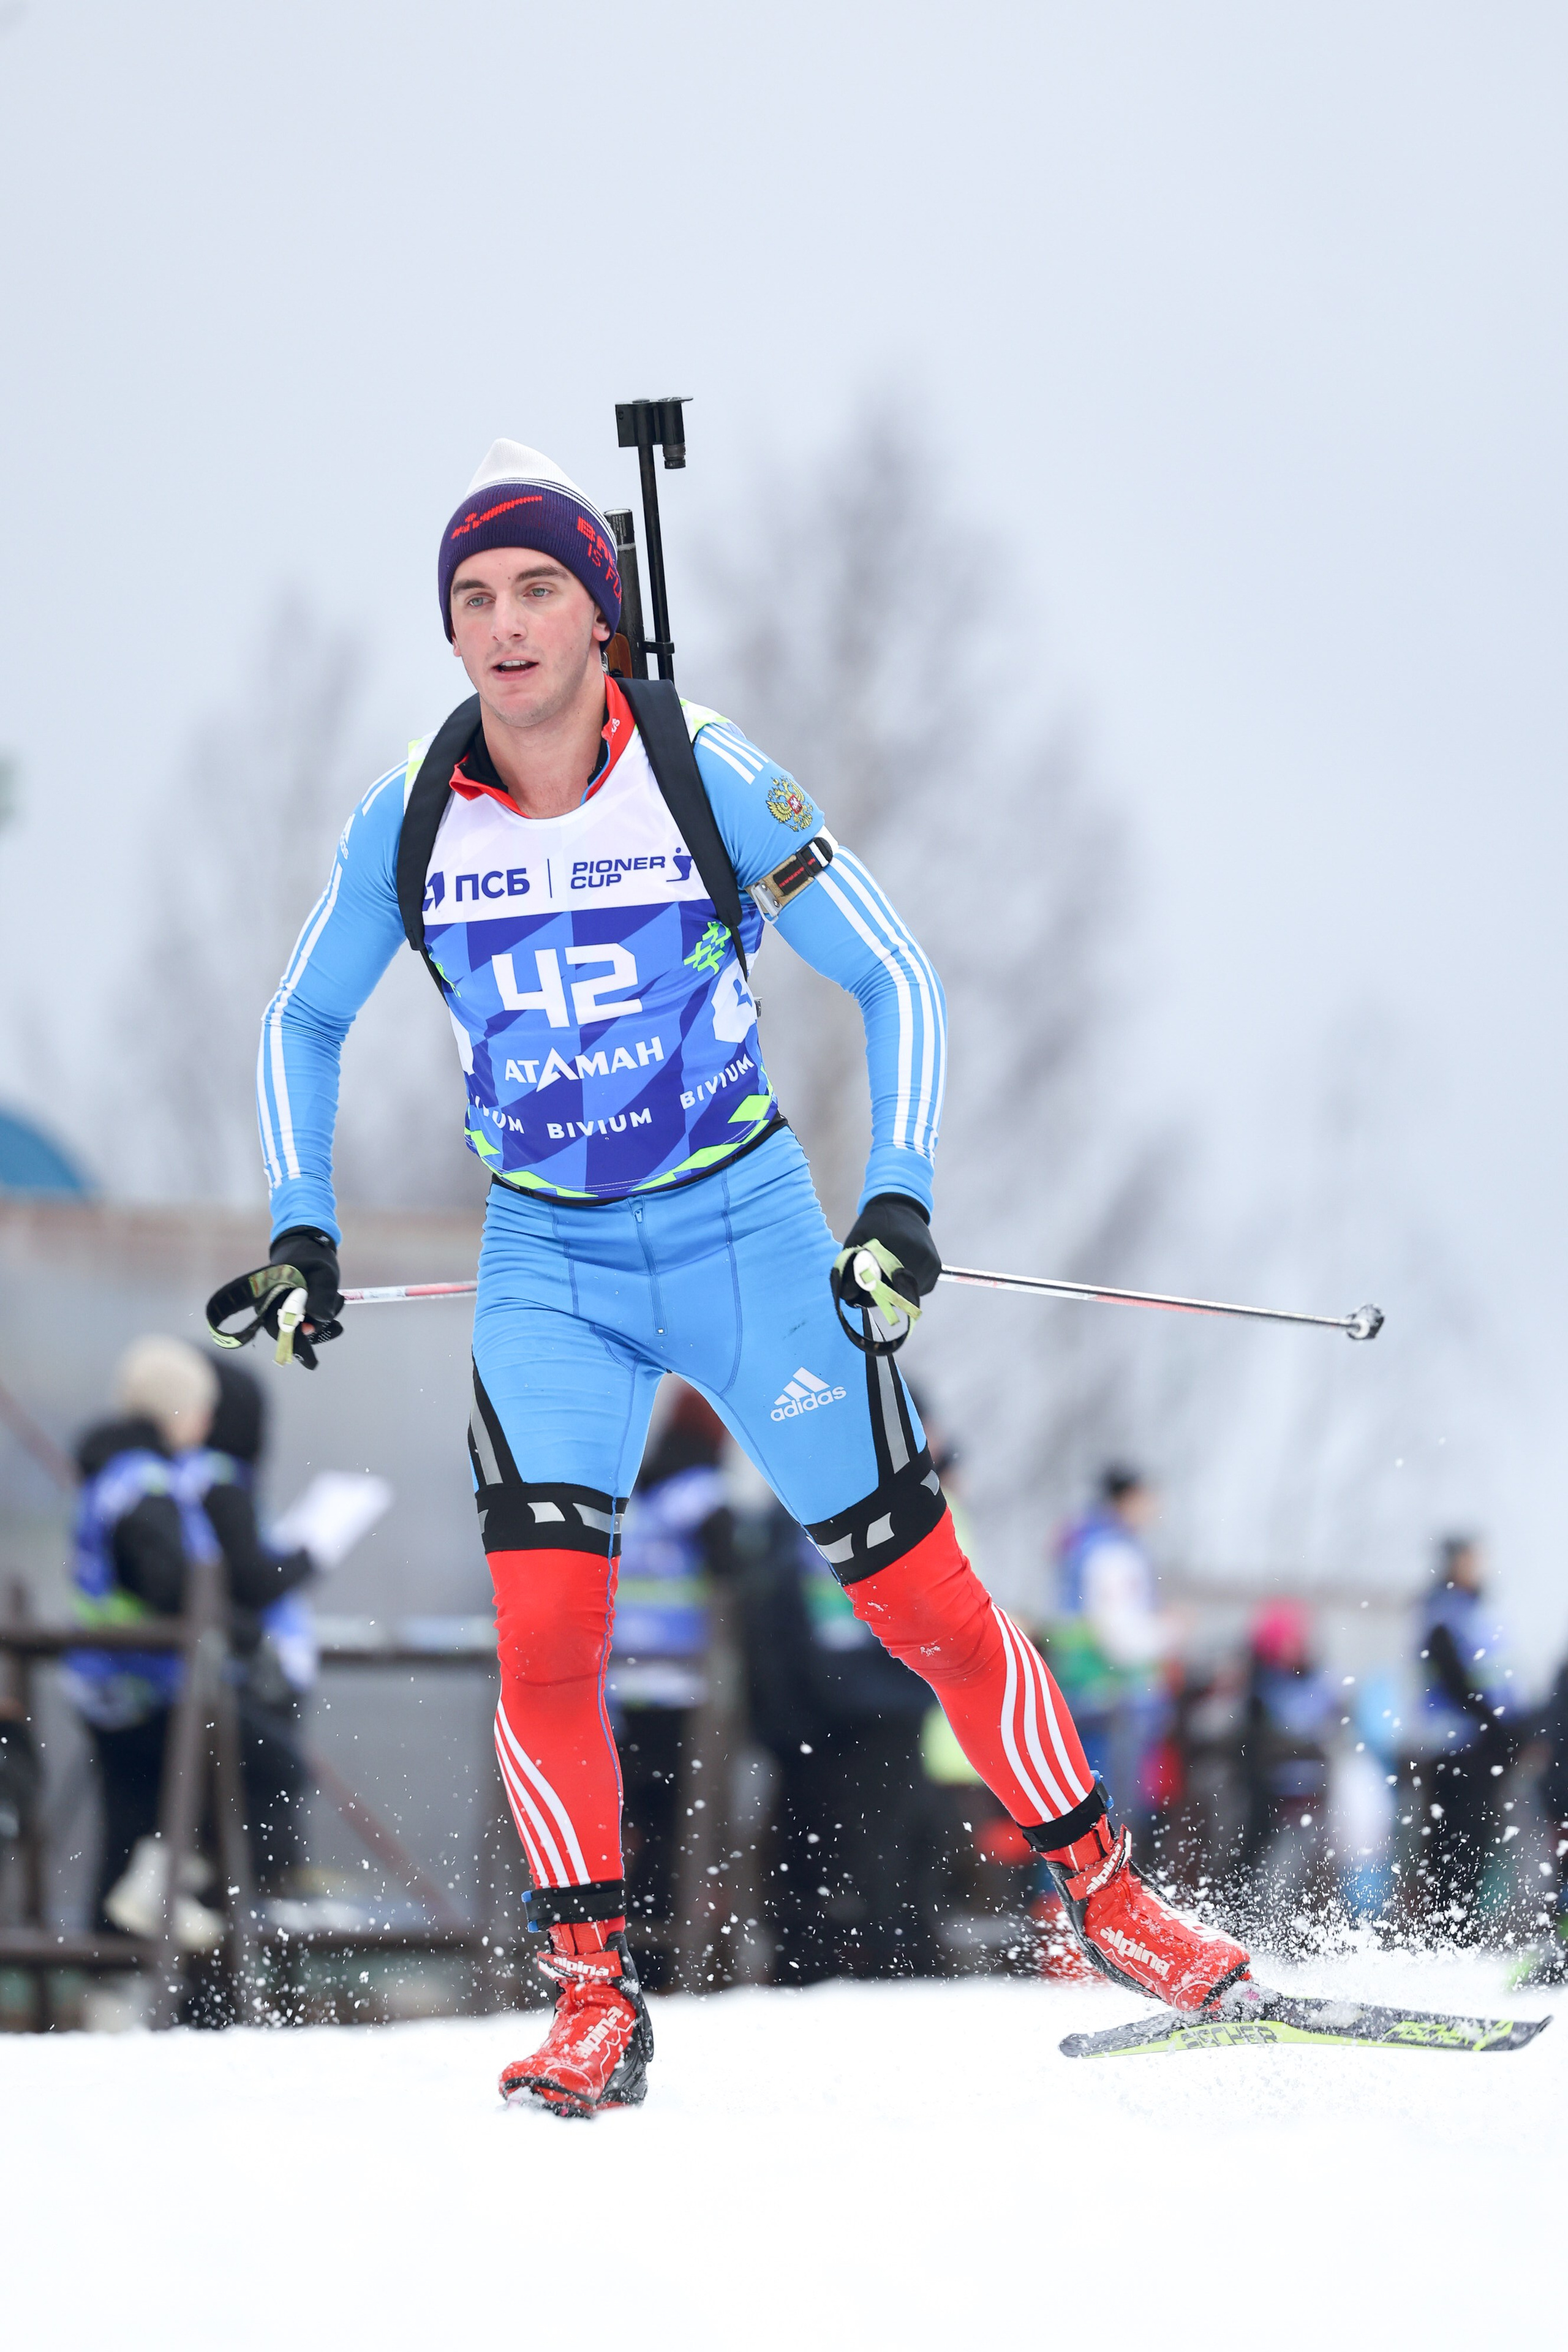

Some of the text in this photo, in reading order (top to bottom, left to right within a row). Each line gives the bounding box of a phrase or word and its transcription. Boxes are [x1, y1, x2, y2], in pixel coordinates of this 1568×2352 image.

[587, 543, 622, 604] IS FU
[454, 867, 530, 902] ПСБ
[570, 873, 622, 889] CUP
[572, 856, 666, 875] PIONER
[491, 943, 643, 1028] 42
[505, 1036, 665, 1093] АТАМАН
[546, 1107, 653, 1139] BIVIUM
[679, 1053, 755, 1110] BIVIUM
[770, 1386, 847, 1422] adidas
[1086, 1843, 1121, 1895] alpina
[553, 1956, 609, 1977] alpina
[1100, 1926, 1170, 1977] alpina
